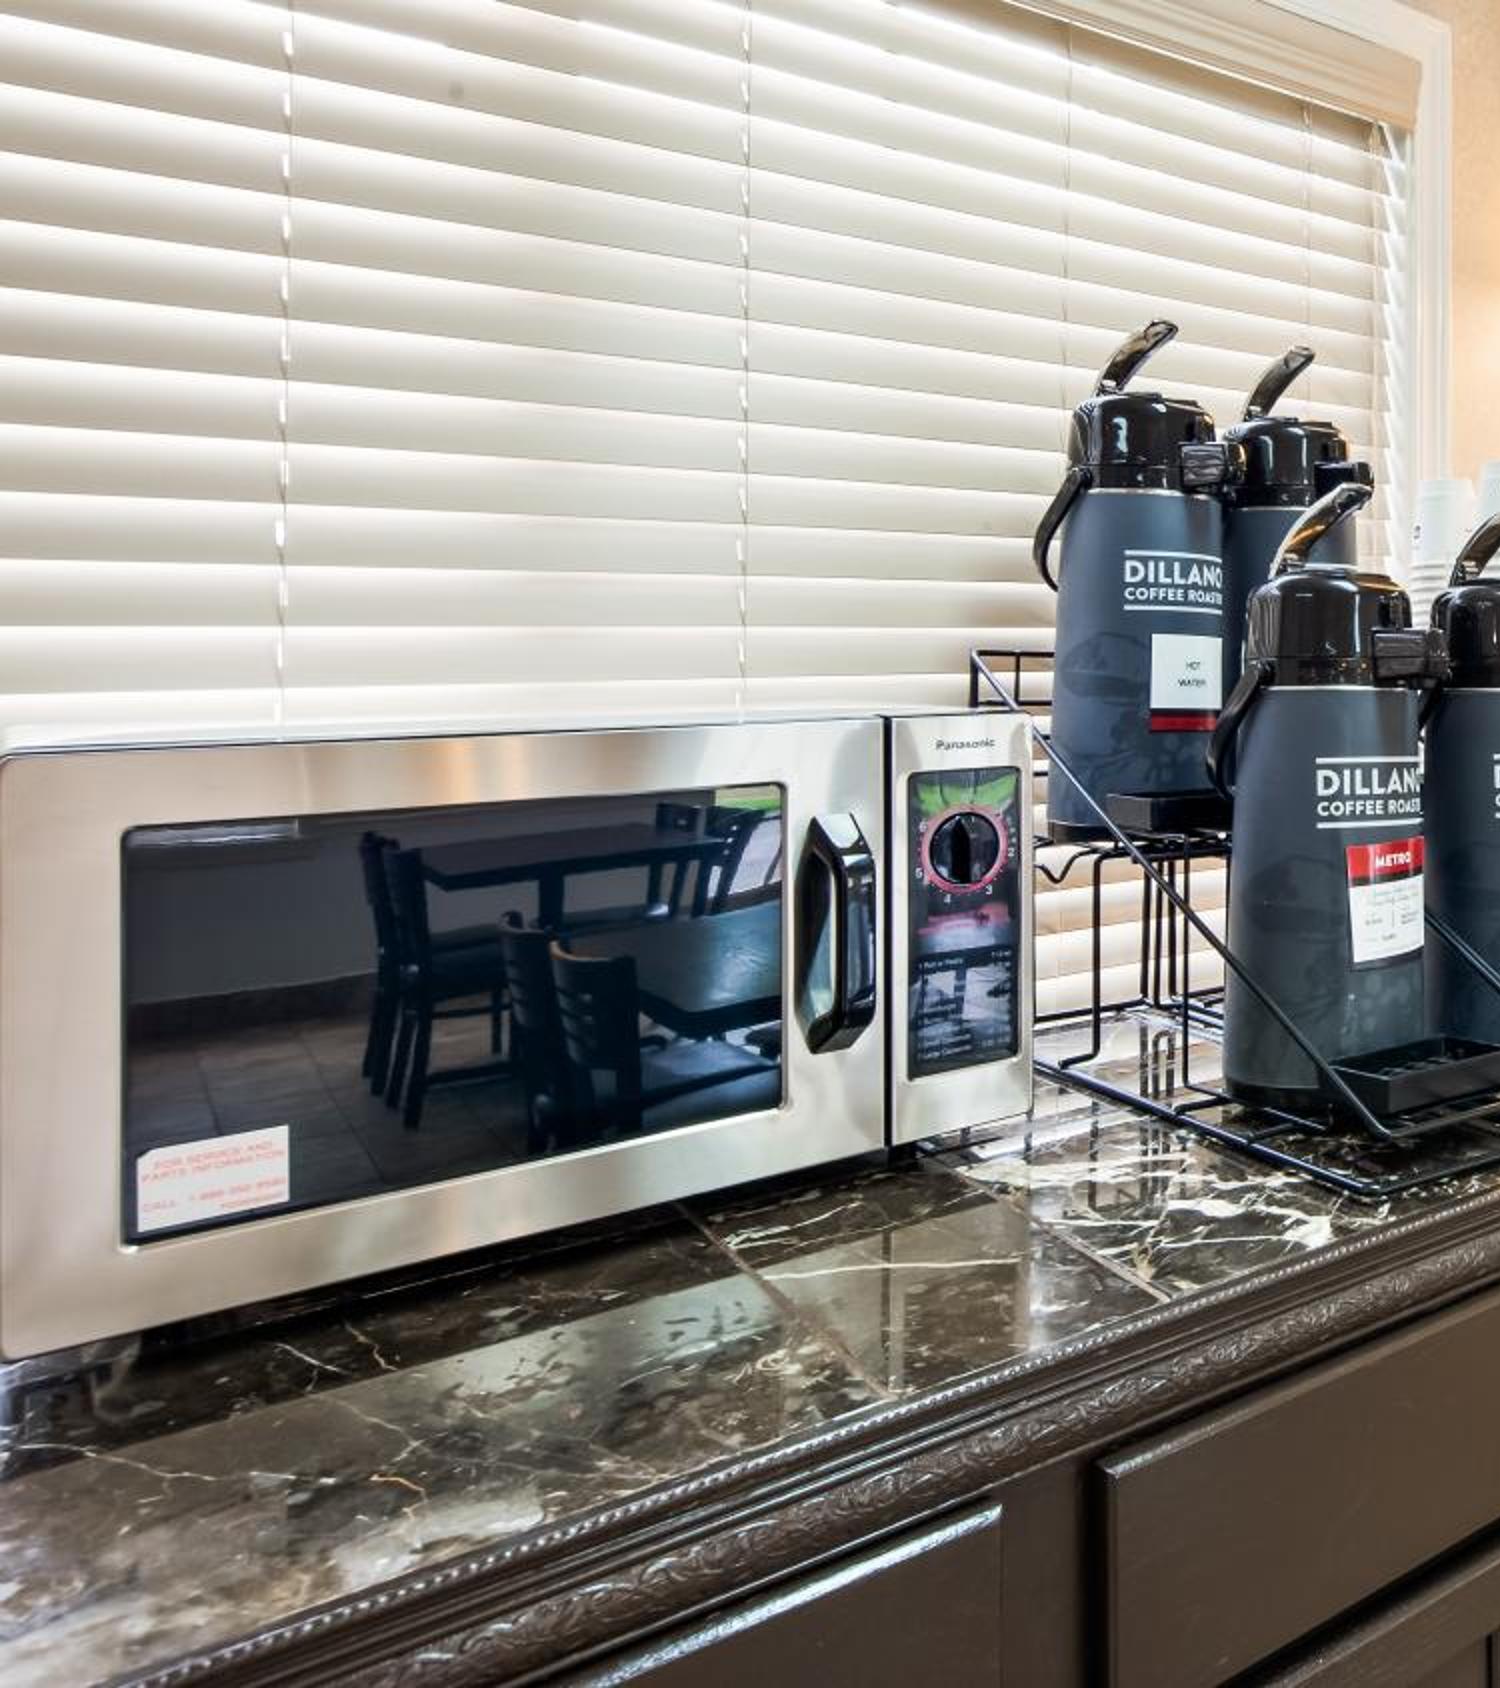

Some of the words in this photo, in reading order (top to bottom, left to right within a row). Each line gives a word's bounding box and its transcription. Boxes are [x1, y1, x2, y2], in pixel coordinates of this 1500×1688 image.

[1124, 587, 1185, 601] COFFEE
[936, 737, 996, 752] Panasonic
[1317, 799, 1385, 816] COFFEE
[1375, 852, 1412, 867] METRO
